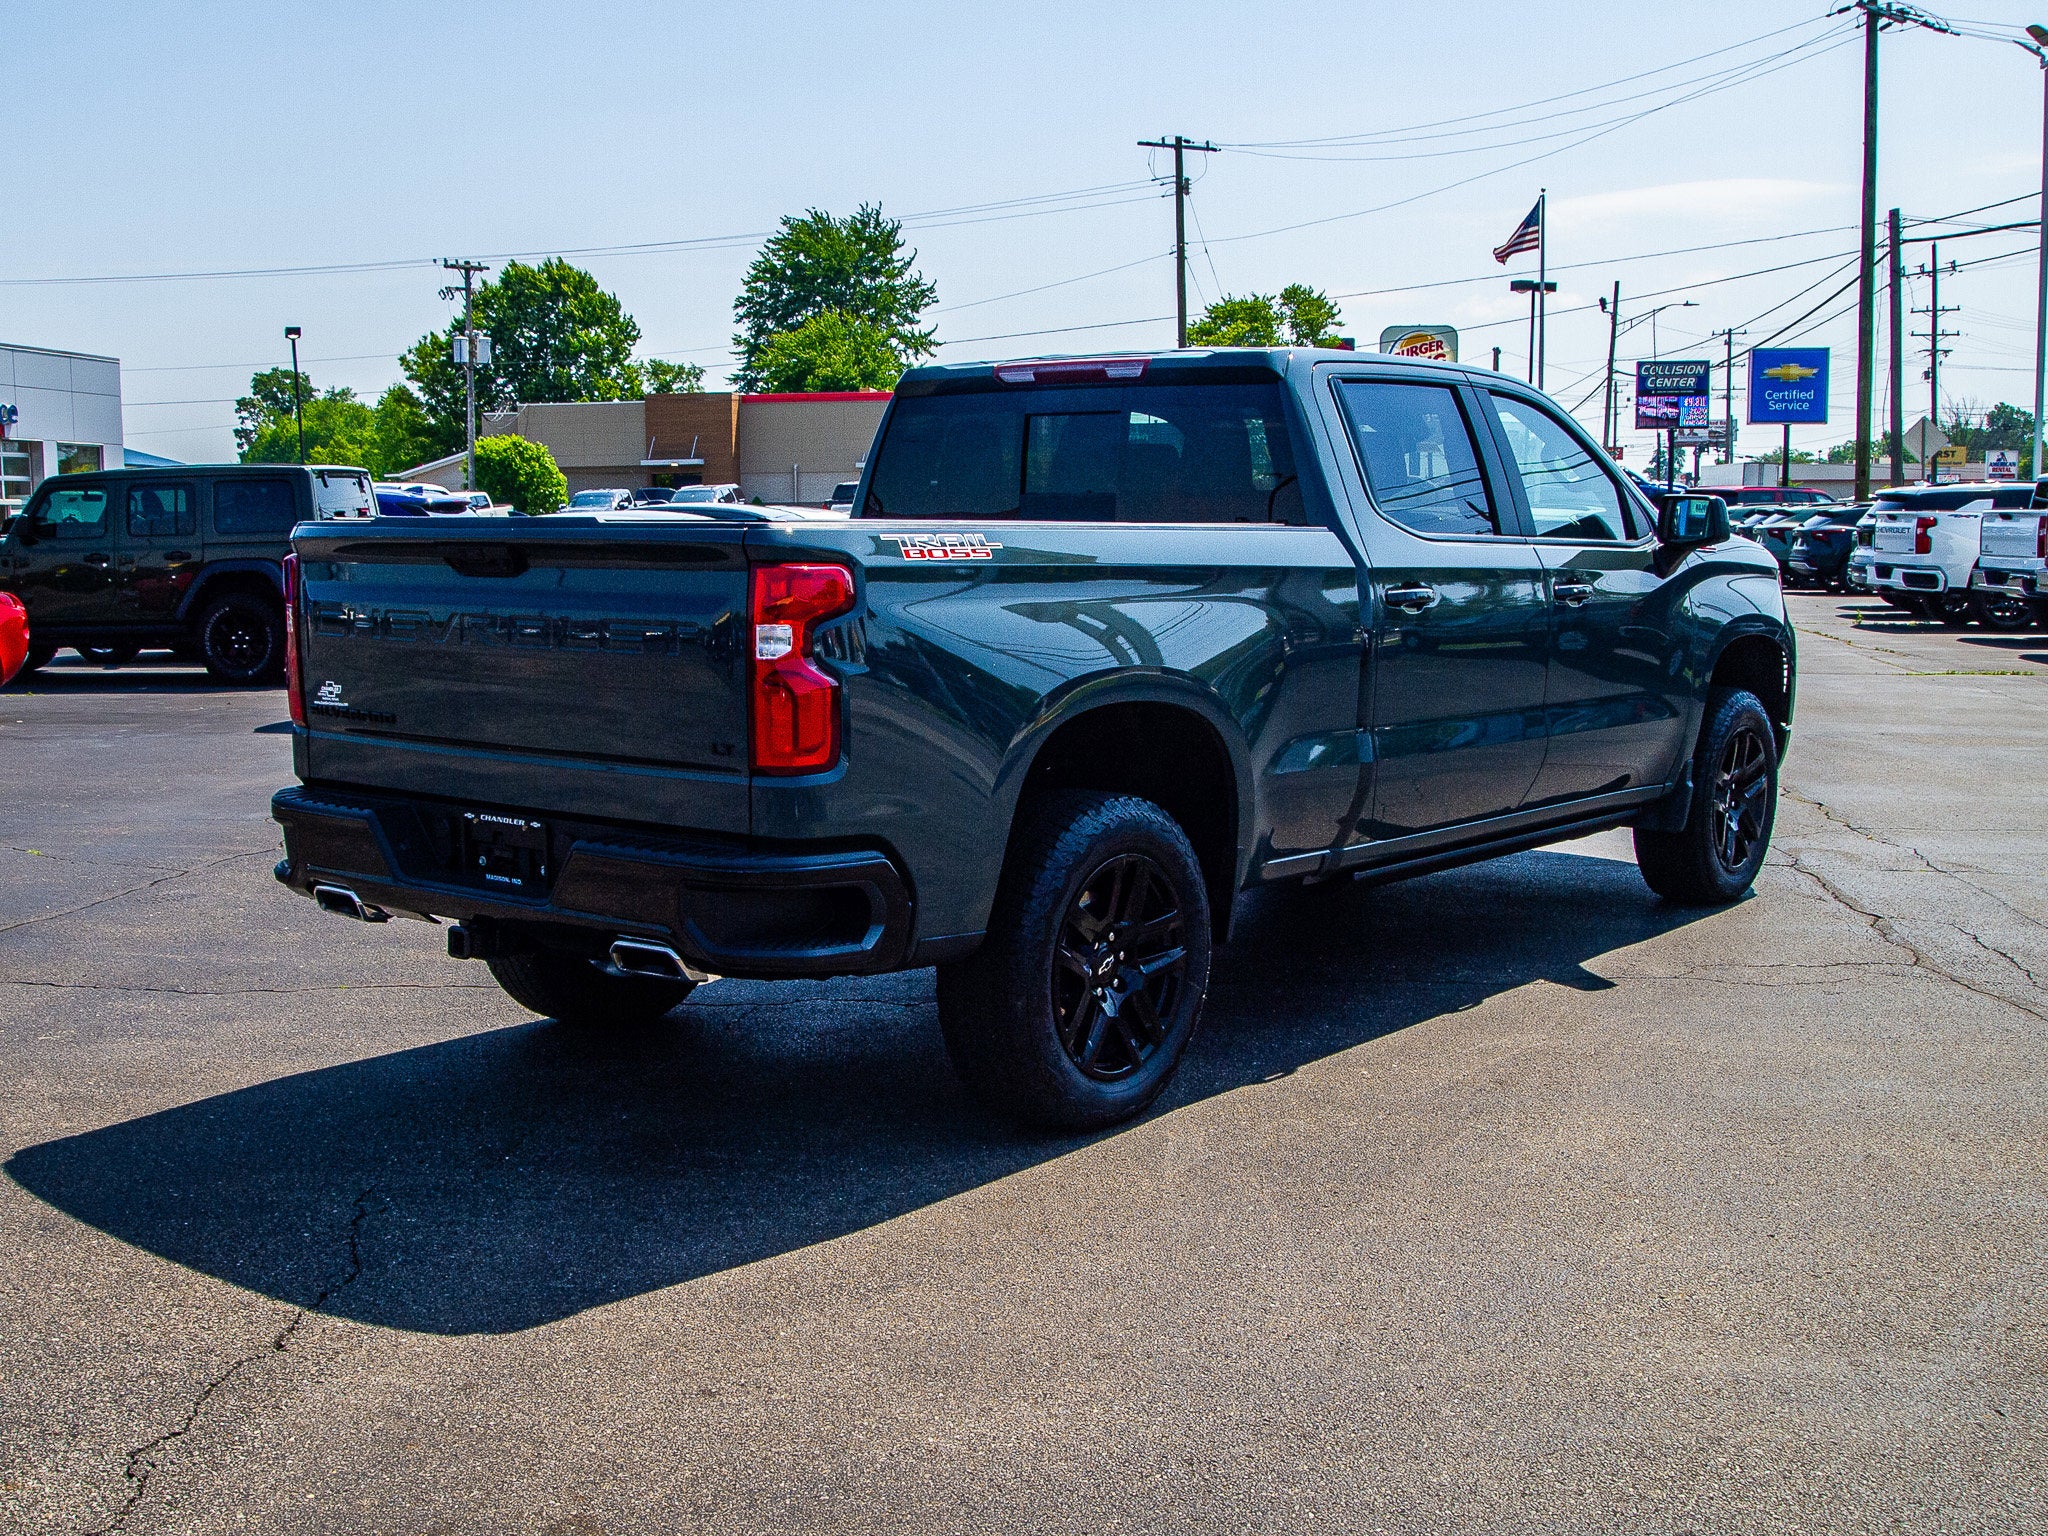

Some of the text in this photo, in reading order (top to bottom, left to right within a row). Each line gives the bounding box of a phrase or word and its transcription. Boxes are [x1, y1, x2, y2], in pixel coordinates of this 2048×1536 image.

[1641, 364, 1705, 375] COLLISION
[1647, 377, 1696, 387] CENTER
[1765, 389, 1814, 400] Certified
[1768, 400, 1809, 410] Service
[880, 533, 1003, 549] TRAIL
[901, 548, 993, 561] BOSS
[480, 814, 526, 826] CHANDLER
